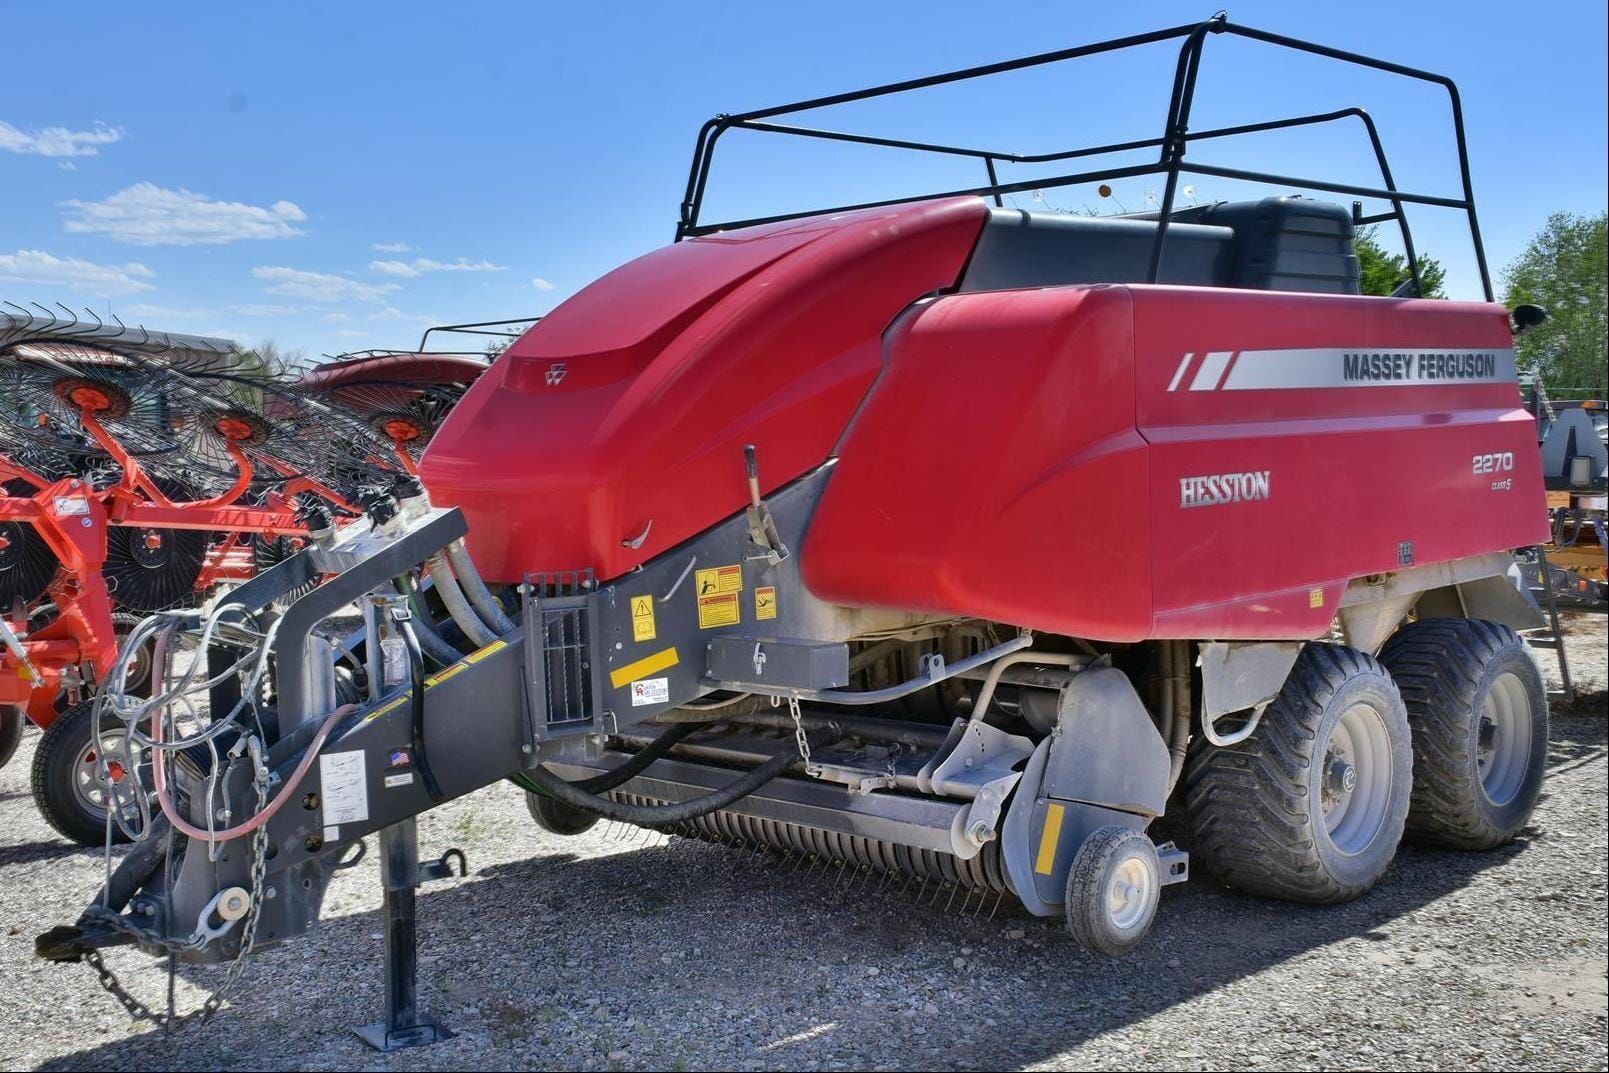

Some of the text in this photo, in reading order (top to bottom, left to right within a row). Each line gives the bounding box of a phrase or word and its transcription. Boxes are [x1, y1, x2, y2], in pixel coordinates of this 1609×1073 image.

[1343, 353, 1496, 381] MASSEY FERGUSON
[1472, 452, 1513, 474] 2270
[1180, 470, 1270, 509] HESSTON
